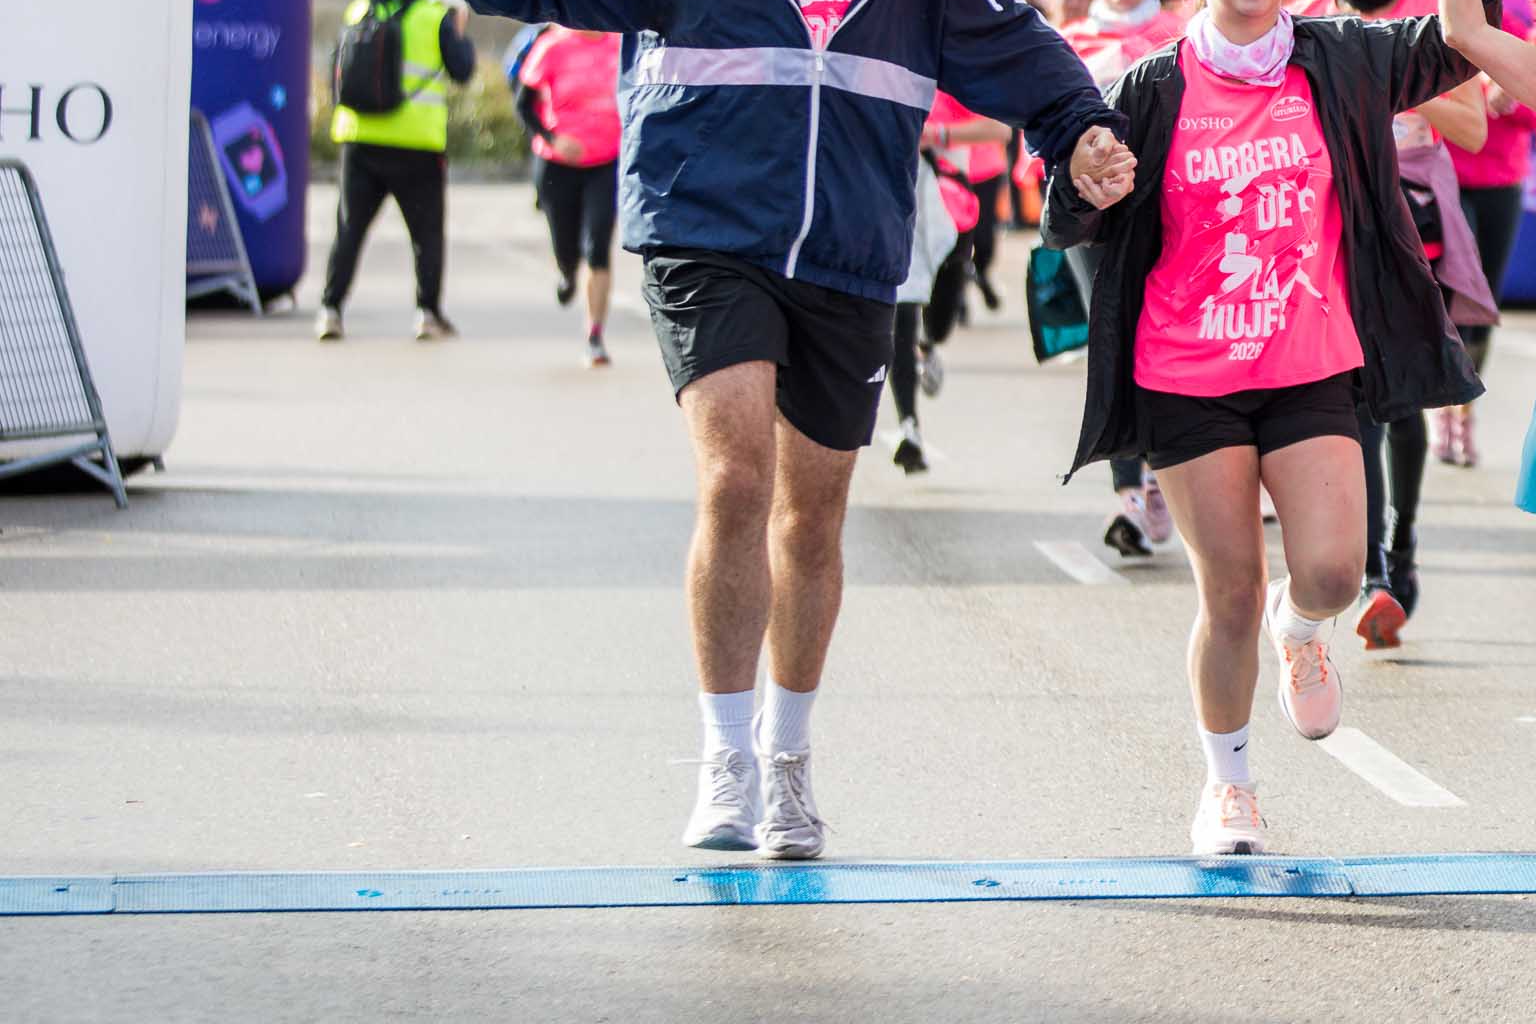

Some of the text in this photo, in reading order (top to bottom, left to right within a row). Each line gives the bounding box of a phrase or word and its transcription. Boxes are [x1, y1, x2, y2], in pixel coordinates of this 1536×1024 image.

[1178, 118, 1233, 130] OYSHO
[1257, 182, 1292, 231] DE
[1250, 261, 1279, 299] LA
